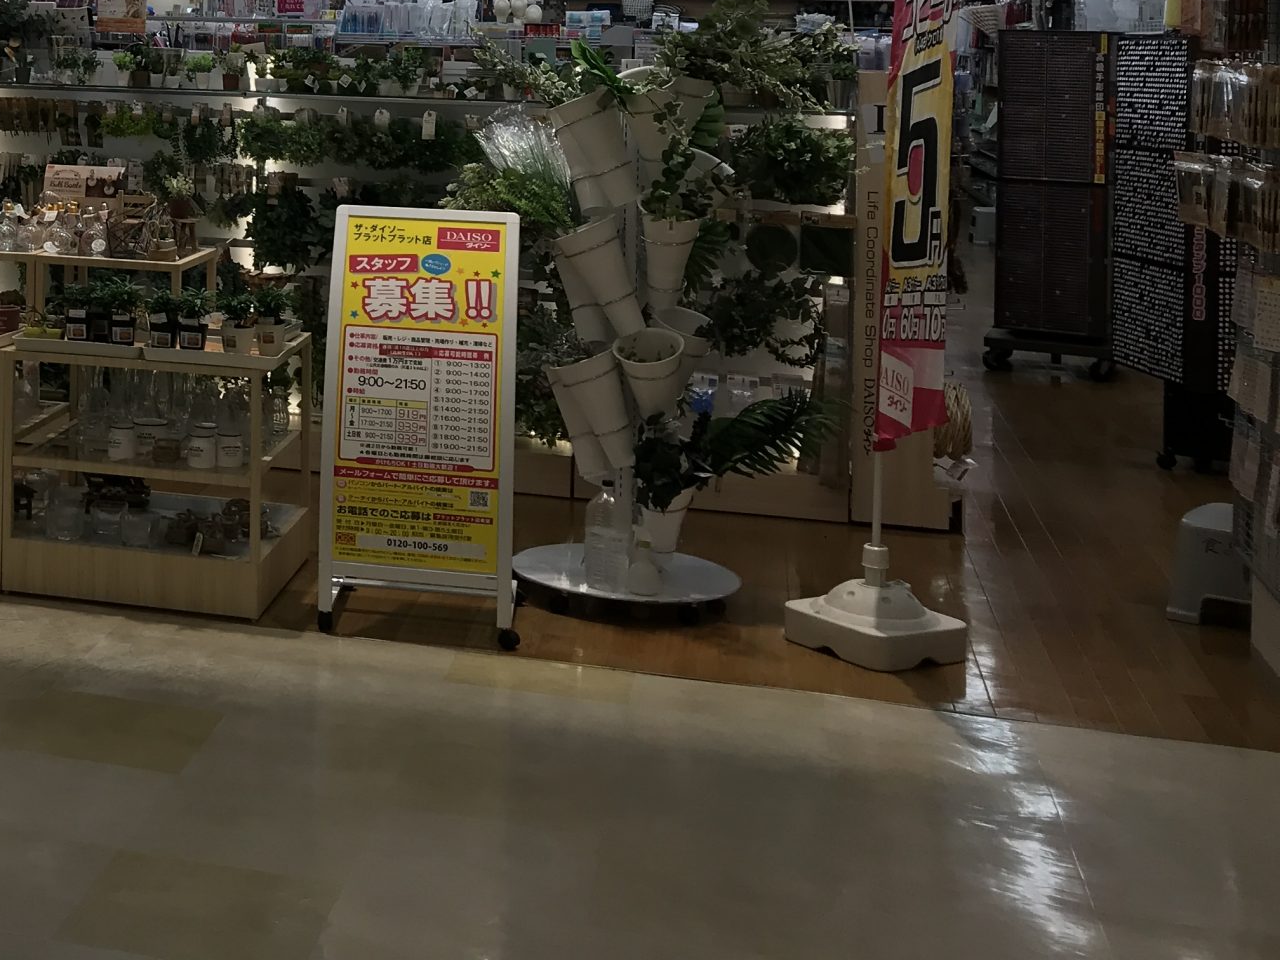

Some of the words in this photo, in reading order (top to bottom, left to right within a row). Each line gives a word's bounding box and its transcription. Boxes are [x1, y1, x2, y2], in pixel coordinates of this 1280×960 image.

[867, 191, 879, 221] Life
[354, 224, 405, 234] ザ・ダイソー
[446, 231, 492, 242] DAISO
[356, 257, 411, 271] スタッフ
[865, 226, 879, 318] Coordinate
[862, 324, 876, 368] Shop
[881, 367, 910, 396] AISO
[863, 378, 876, 428] DAISO
[387, 539, 449, 552] 0120-100-569
